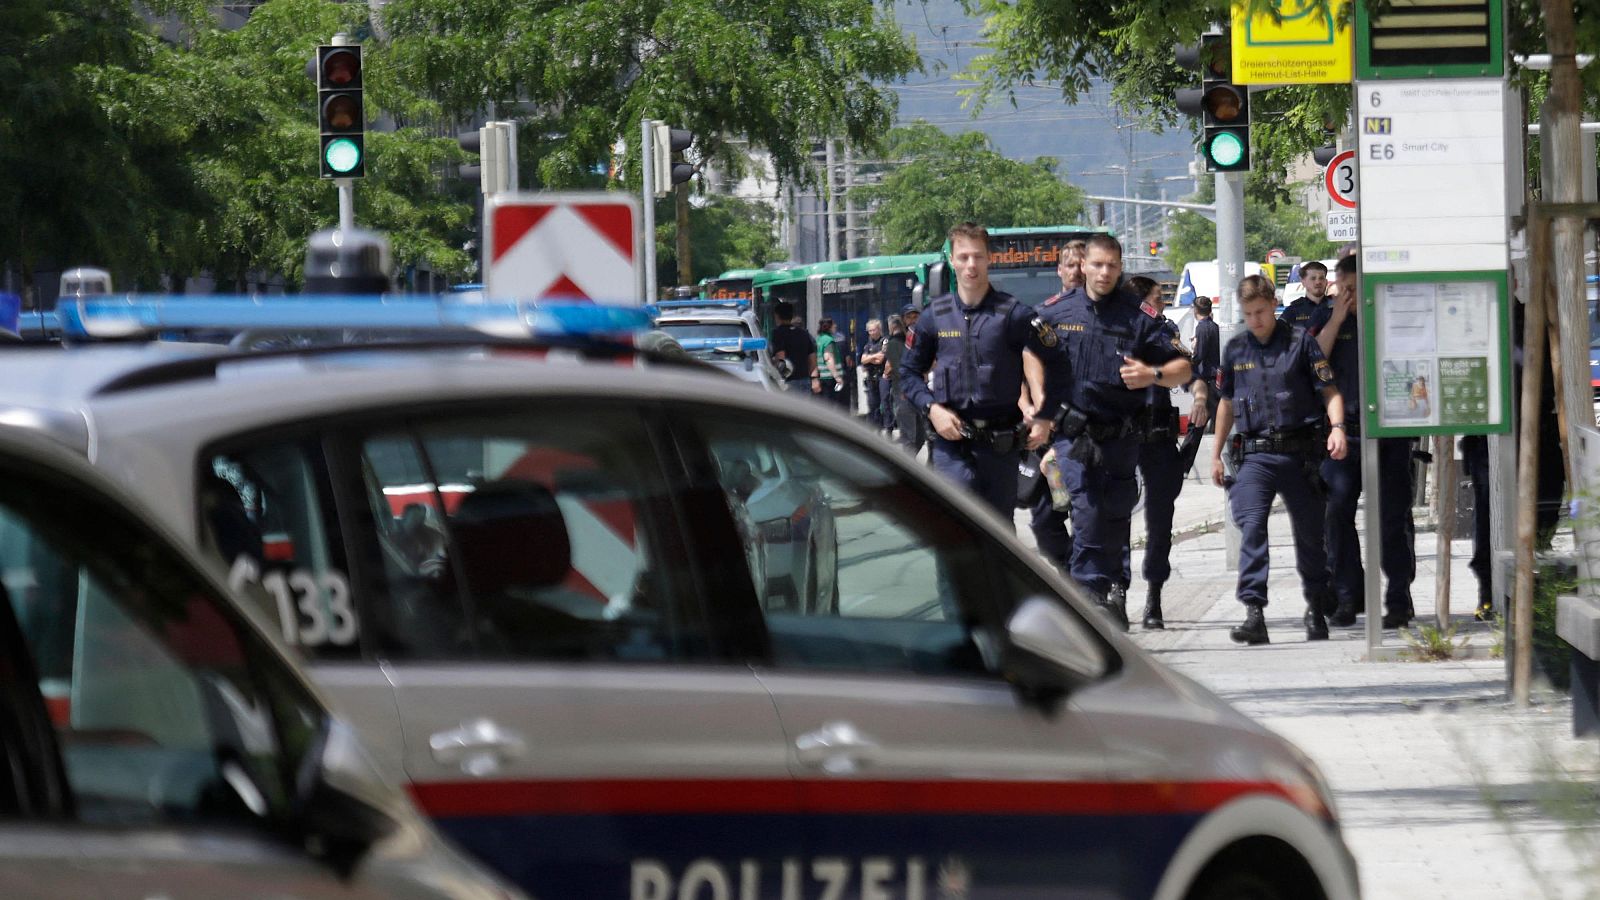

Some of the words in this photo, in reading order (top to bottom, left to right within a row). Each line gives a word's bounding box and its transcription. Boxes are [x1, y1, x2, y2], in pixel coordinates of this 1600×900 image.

[1249, 69, 1328, 79] Helmut-List-Halle
[1369, 91, 1382, 108] 6
[1366, 118, 1391, 134] N1
[1369, 144, 1395, 160] E6
[1402, 143, 1428, 152] Smart
[1430, 143, 1449, 153] City
[1340, 165, 1354, 194] 3
[1329, 216, 1339, 225] an
[1333, 229, 1347, 237] von
[987, 245, 1060, 264] nderfah
[1057, 323, 1084, 331] POLIZEI
[262, 568, 357, 646] 133
